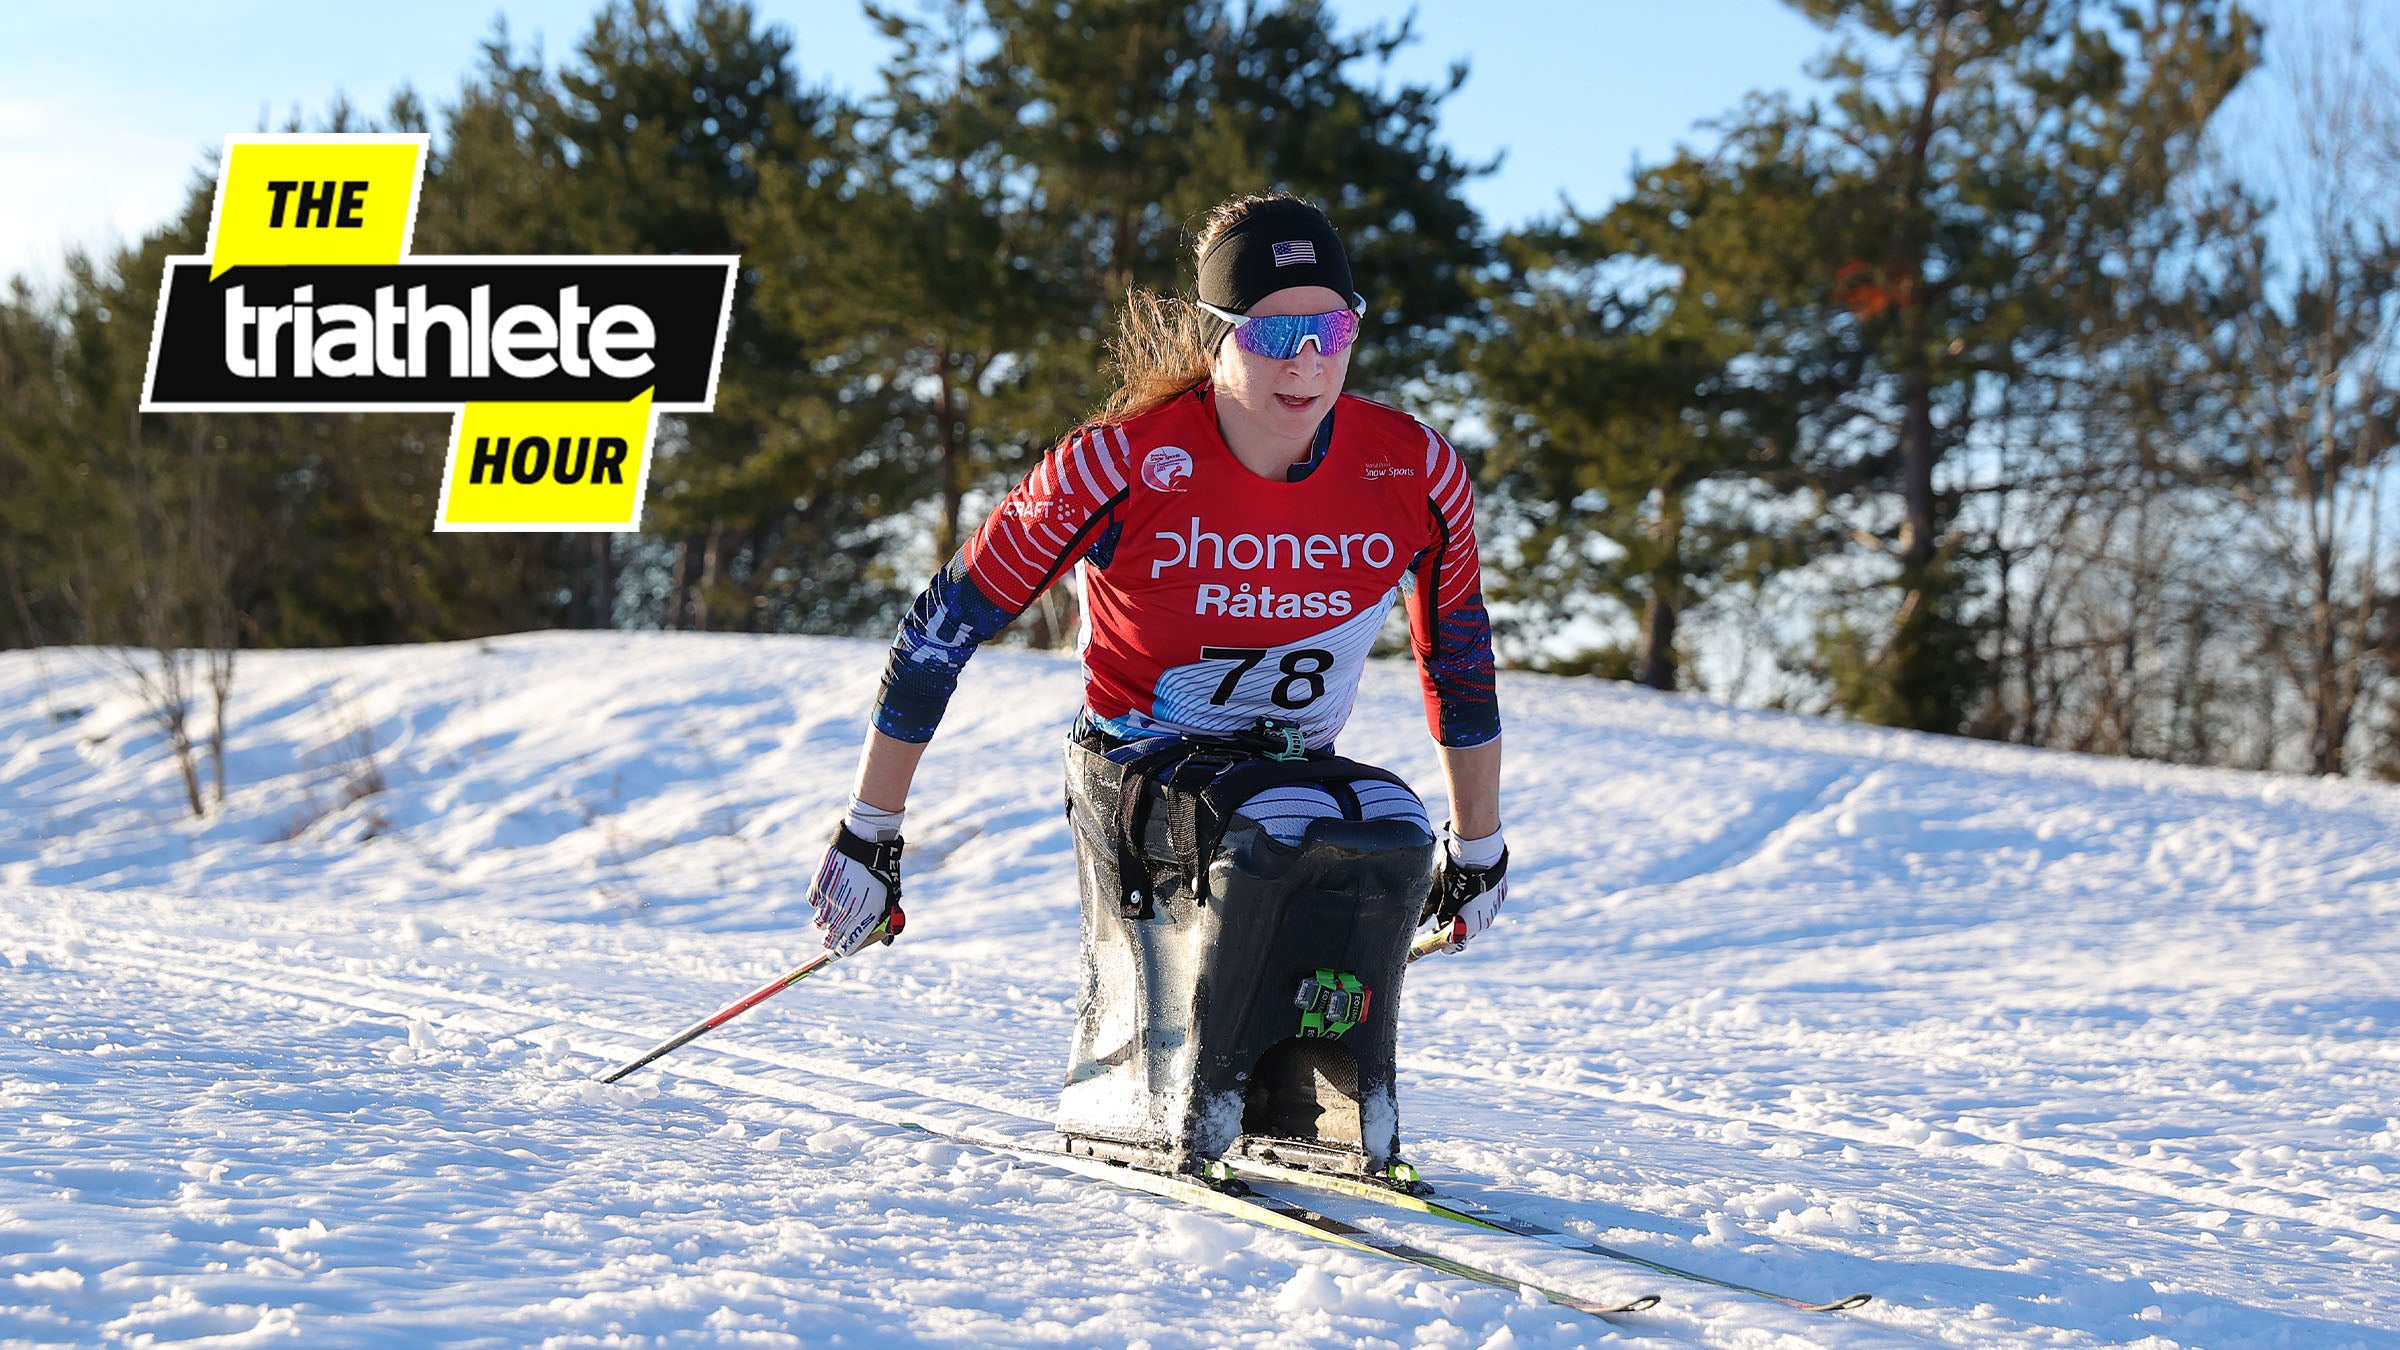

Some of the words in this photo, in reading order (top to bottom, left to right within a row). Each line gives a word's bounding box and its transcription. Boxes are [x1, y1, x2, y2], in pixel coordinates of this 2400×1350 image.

[1365, 468, 1387, 477] Snow
[1388, 467, 1415, 478] Sports
[1003, 501, 1054, 519] CRAFT
[1151, 516, 1395, 579] phonero
[1195, 582, 1353, 620] Råtass
[1200, 646, 1335, 710] 78
